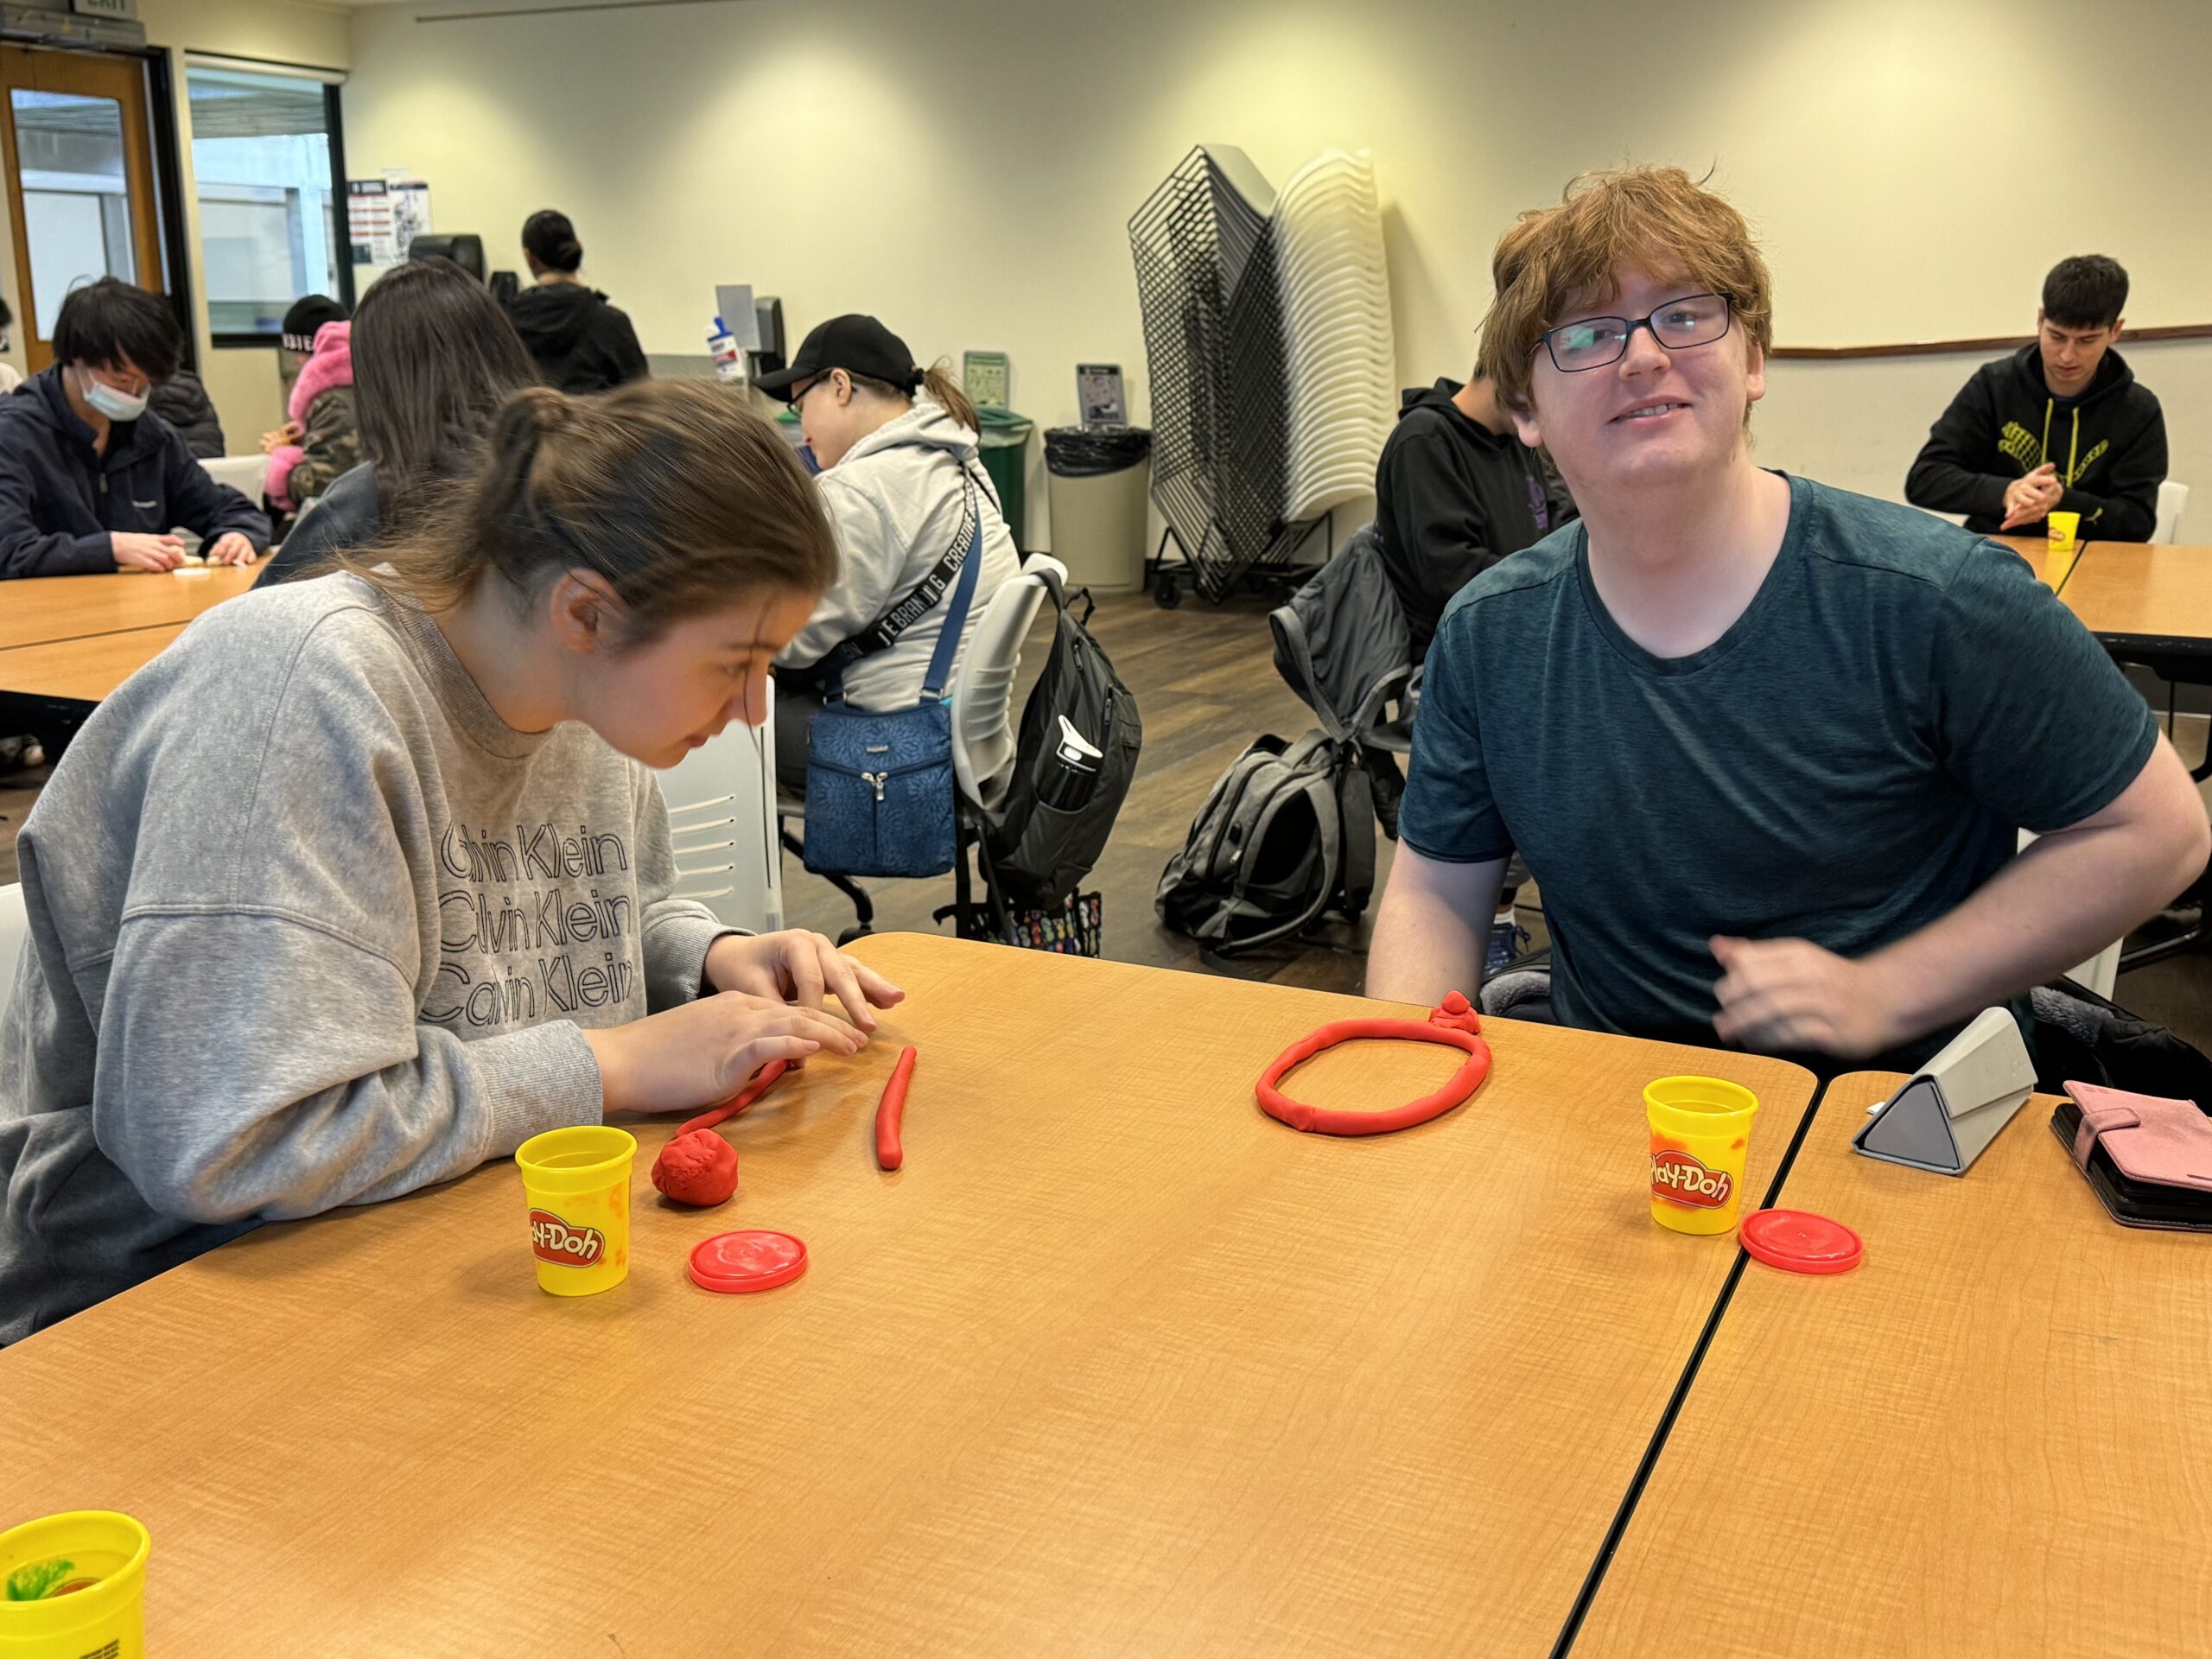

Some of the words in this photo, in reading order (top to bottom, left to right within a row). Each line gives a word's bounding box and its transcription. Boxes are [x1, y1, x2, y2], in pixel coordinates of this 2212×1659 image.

[517, 823, 628, 880] Klein
[535, 887, 632, 949] Klein
[538, 952, 633, 1016] Klein
